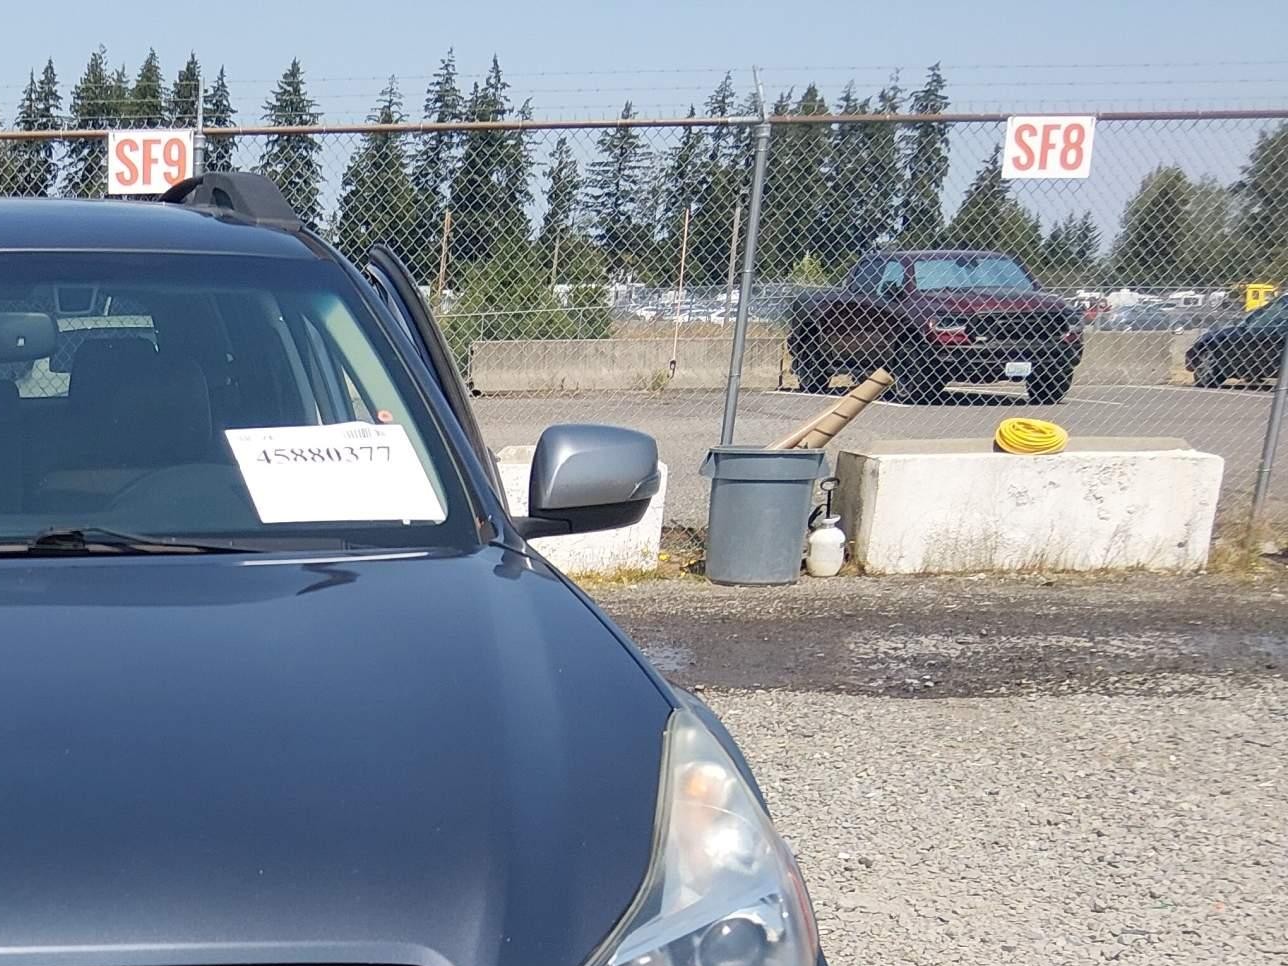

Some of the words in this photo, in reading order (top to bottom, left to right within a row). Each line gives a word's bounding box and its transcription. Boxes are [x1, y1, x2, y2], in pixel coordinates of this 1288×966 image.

[115, 138, 188, 186] SF9
[1012, 123, 1086, 171] SF8
[256, 444, 391, 465] 45880377
